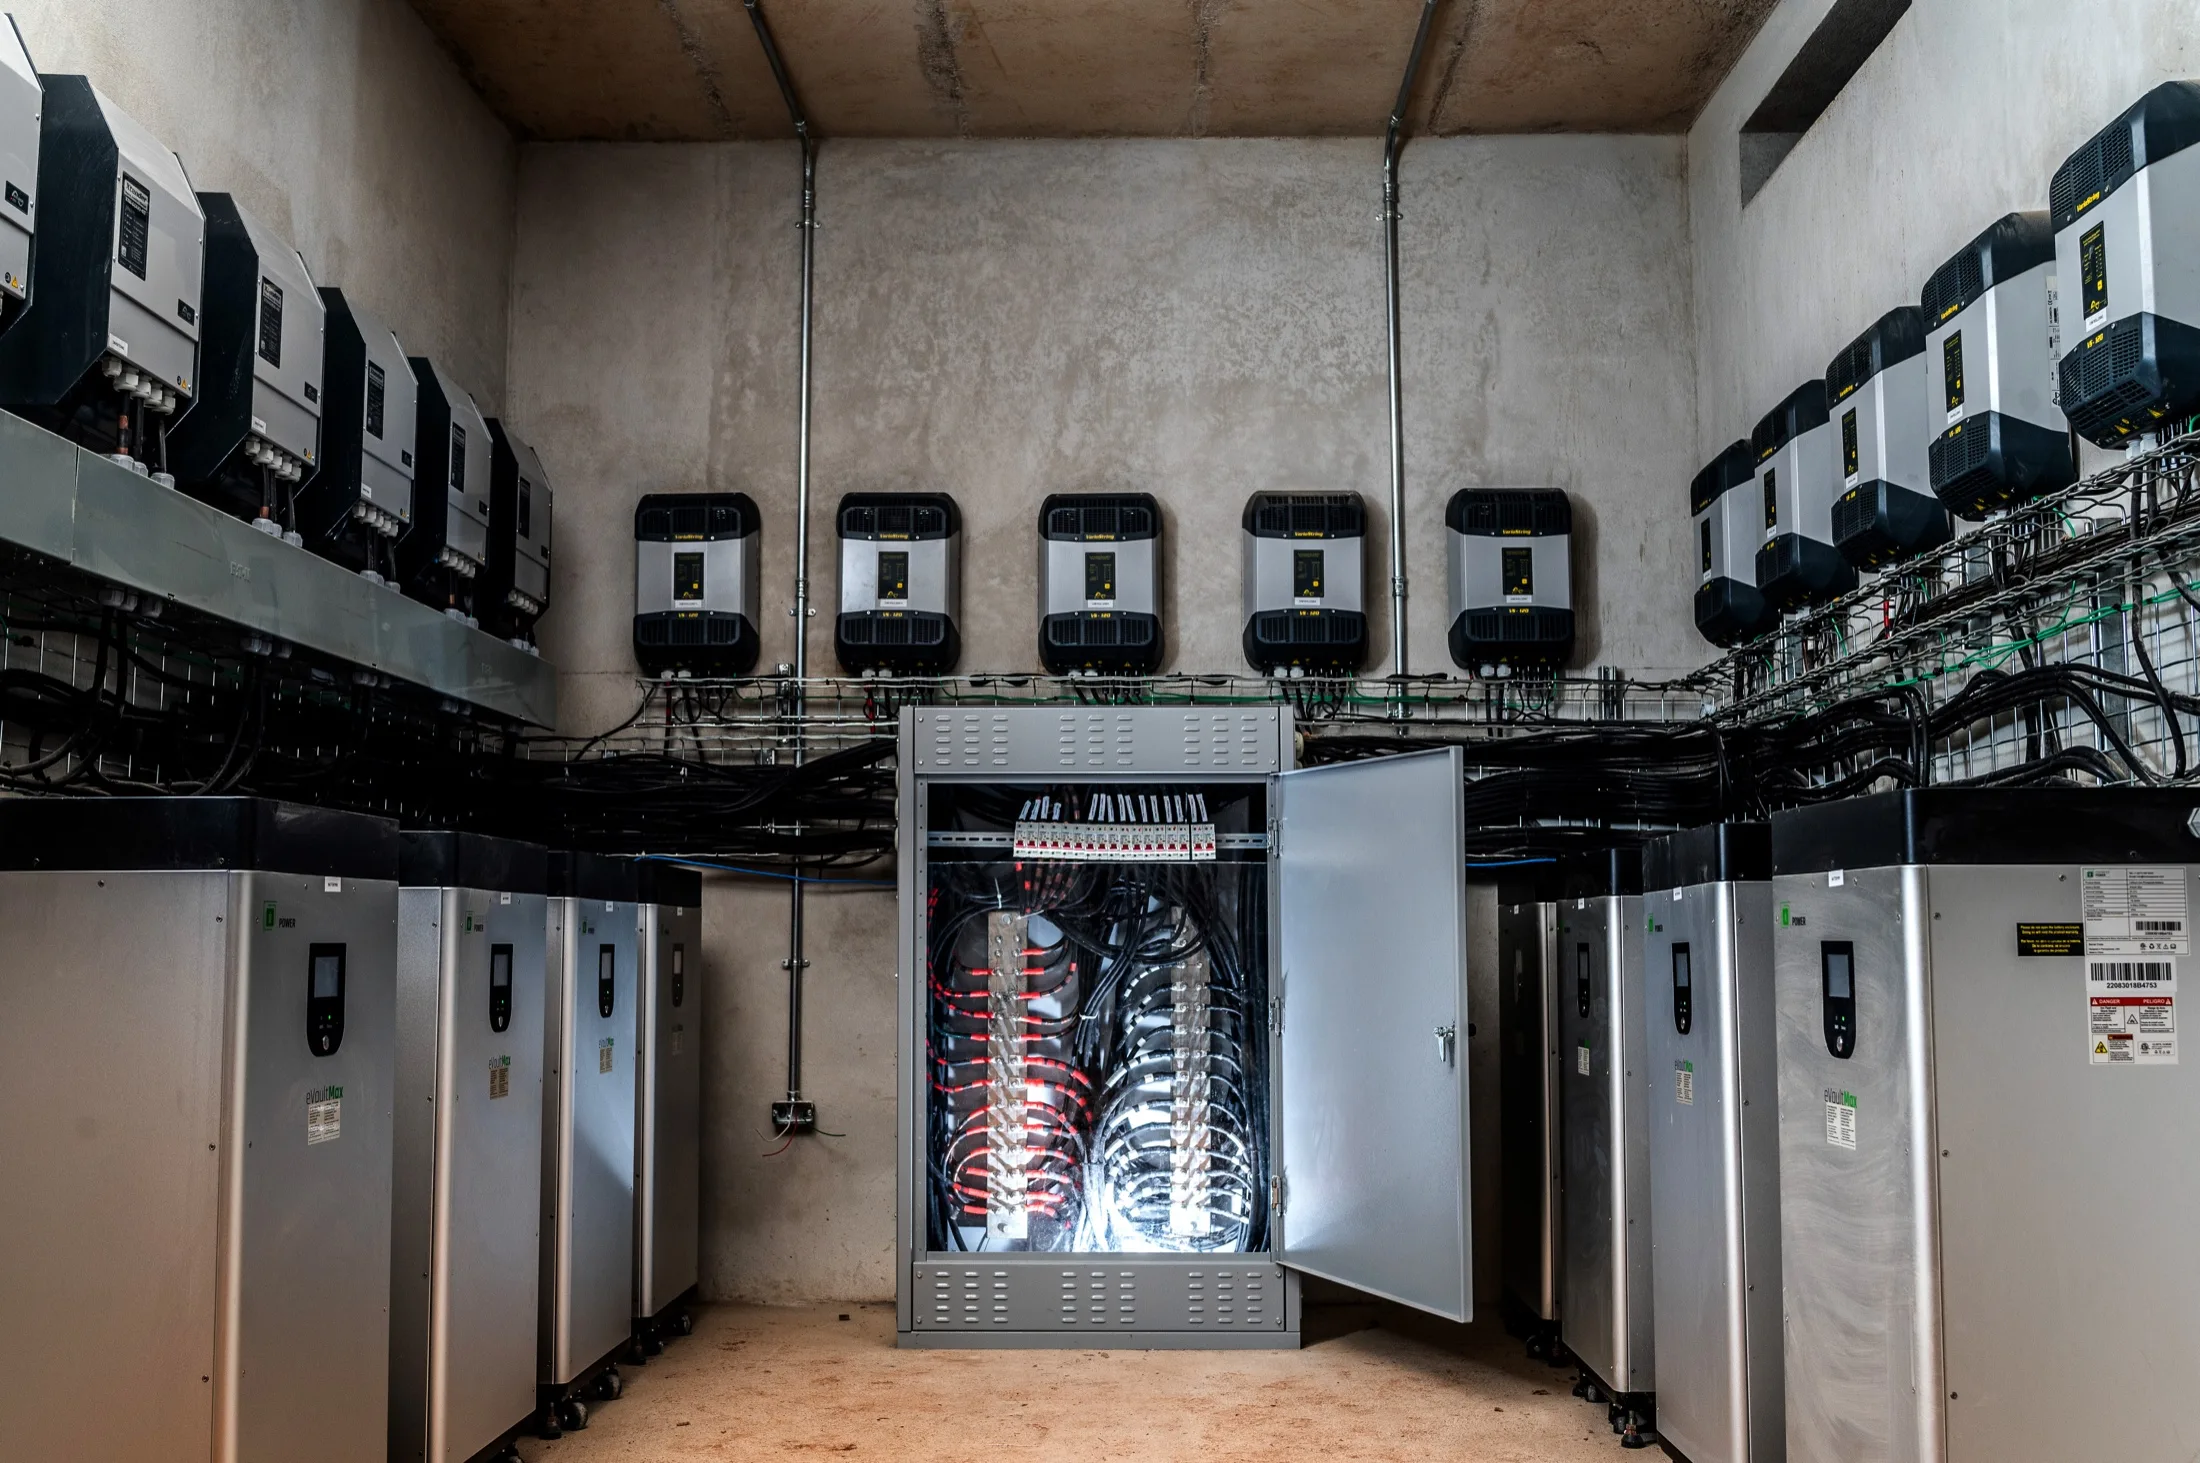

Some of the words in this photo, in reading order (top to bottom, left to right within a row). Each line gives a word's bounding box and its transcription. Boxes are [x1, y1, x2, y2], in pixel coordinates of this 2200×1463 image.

[278, 917, 296, 928] POWER
[1792, 916, 1806, 926] POWER
[306, 1085, 343, 1104] eVaultMax
[1824, 1088, 1857, 1108] eVaultMax
